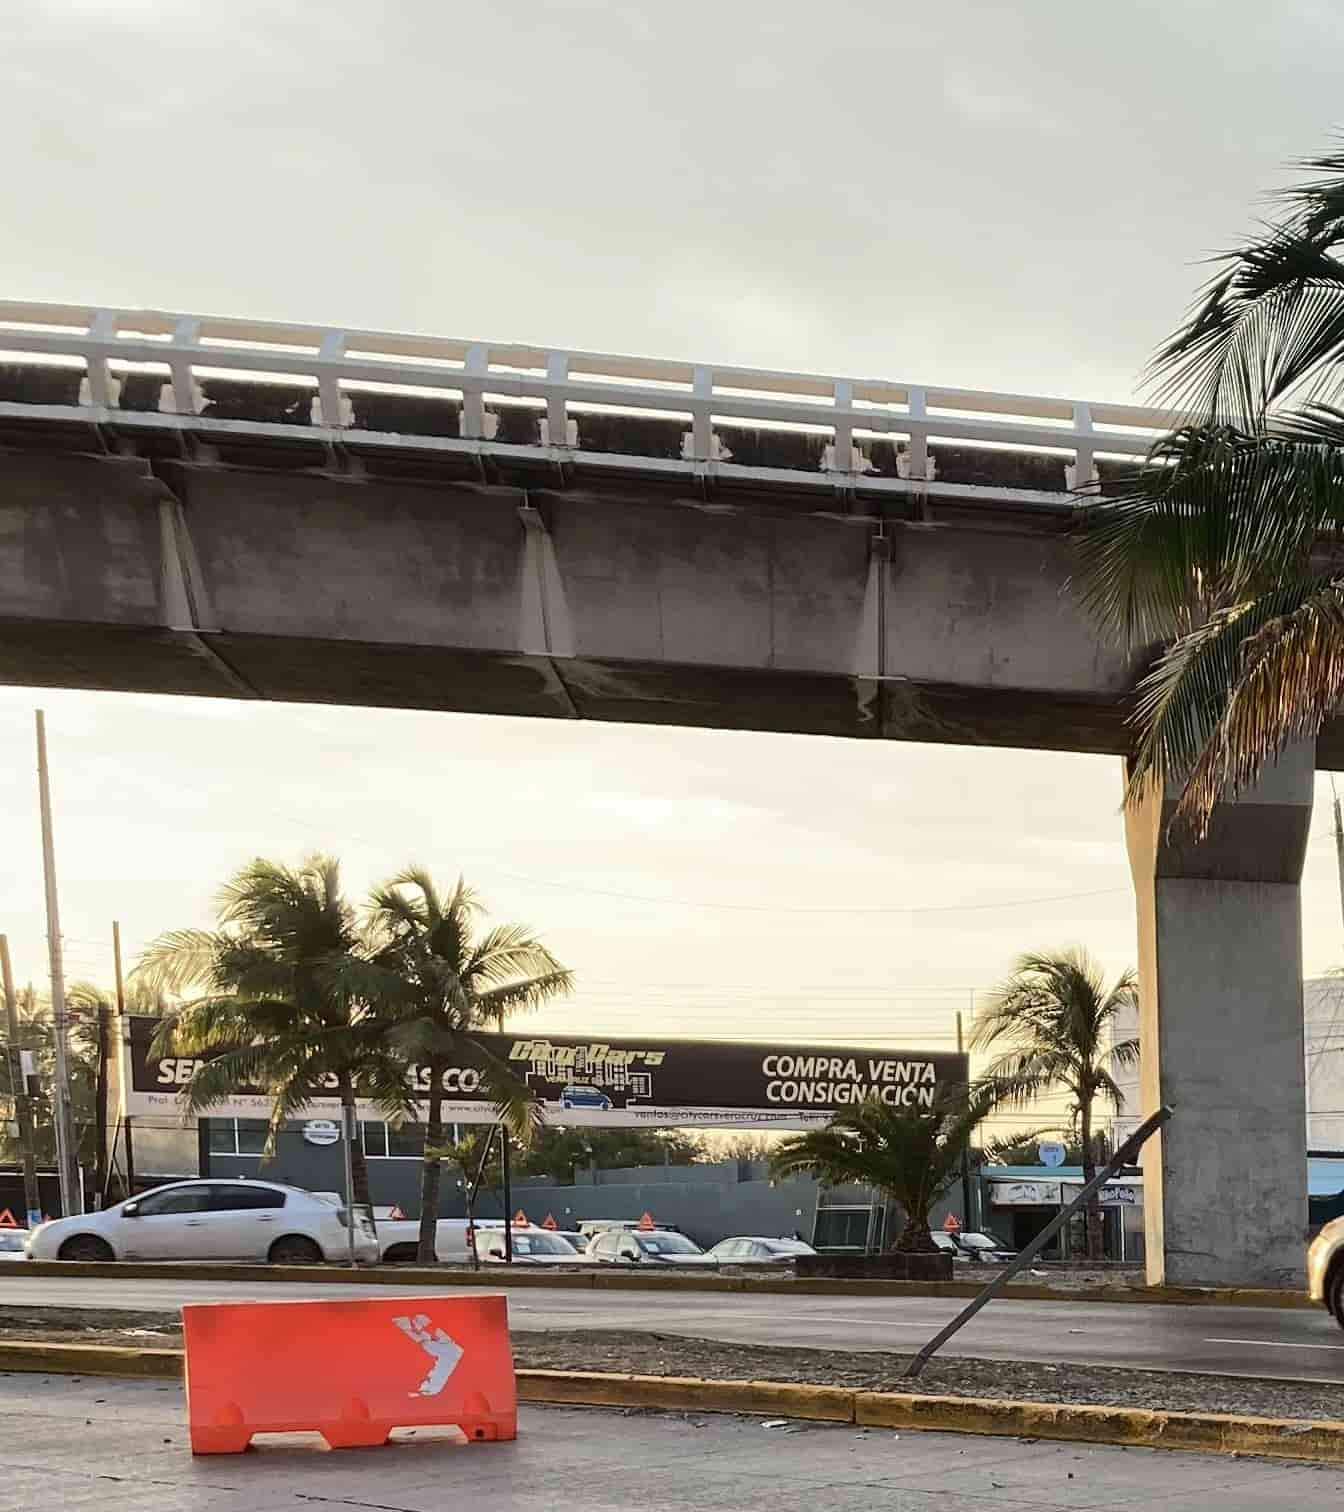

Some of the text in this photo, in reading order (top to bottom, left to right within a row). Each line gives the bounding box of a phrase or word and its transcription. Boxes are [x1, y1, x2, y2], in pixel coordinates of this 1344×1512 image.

[762, 1055, 936, 1084] COMPRA, VENTA
[766, 1080, 934, 1108] CONSIGNACIÓN
